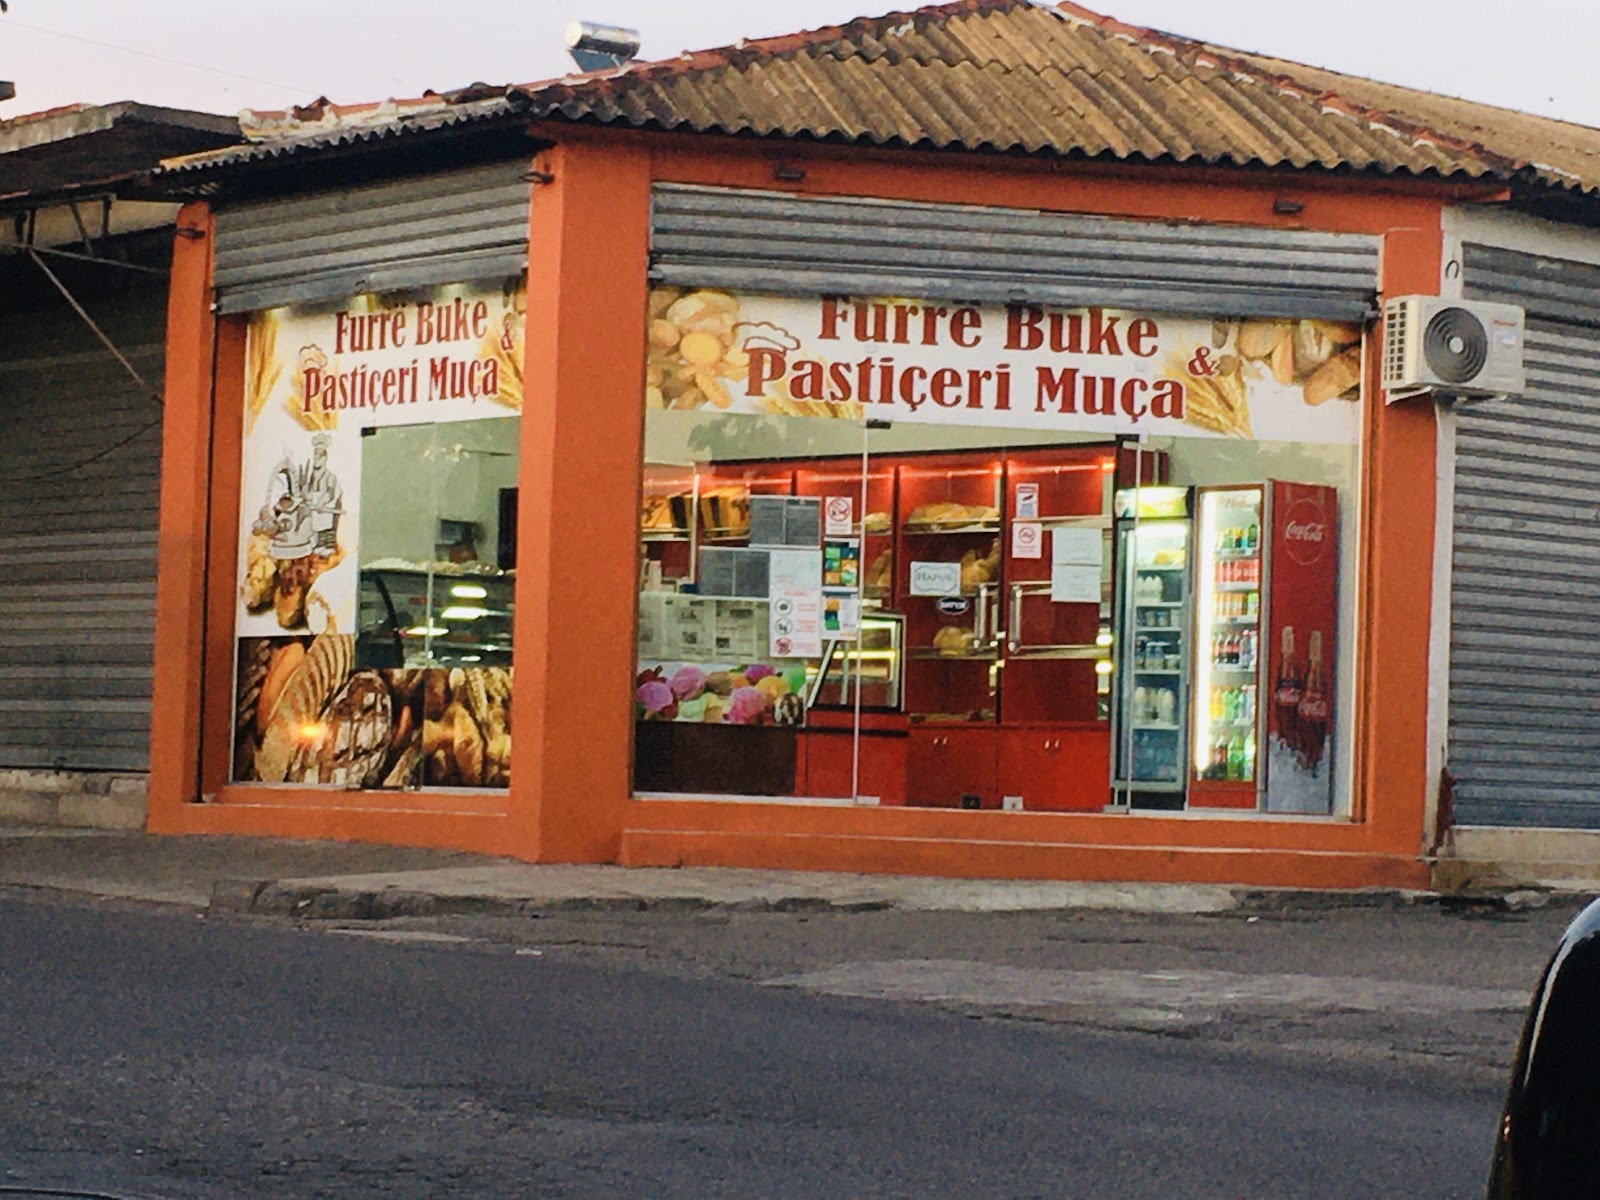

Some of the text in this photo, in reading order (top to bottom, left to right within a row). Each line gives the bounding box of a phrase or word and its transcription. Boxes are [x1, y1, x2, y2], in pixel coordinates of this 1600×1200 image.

[334, 297, 515, 354] Furrë Buke &
[818, 293, 1219, 377] Furrë Buke &
[303, 355, 499, 412] Pastiçeri Muça
[744, 348, 1185, 424] Pastiçeri Muça
